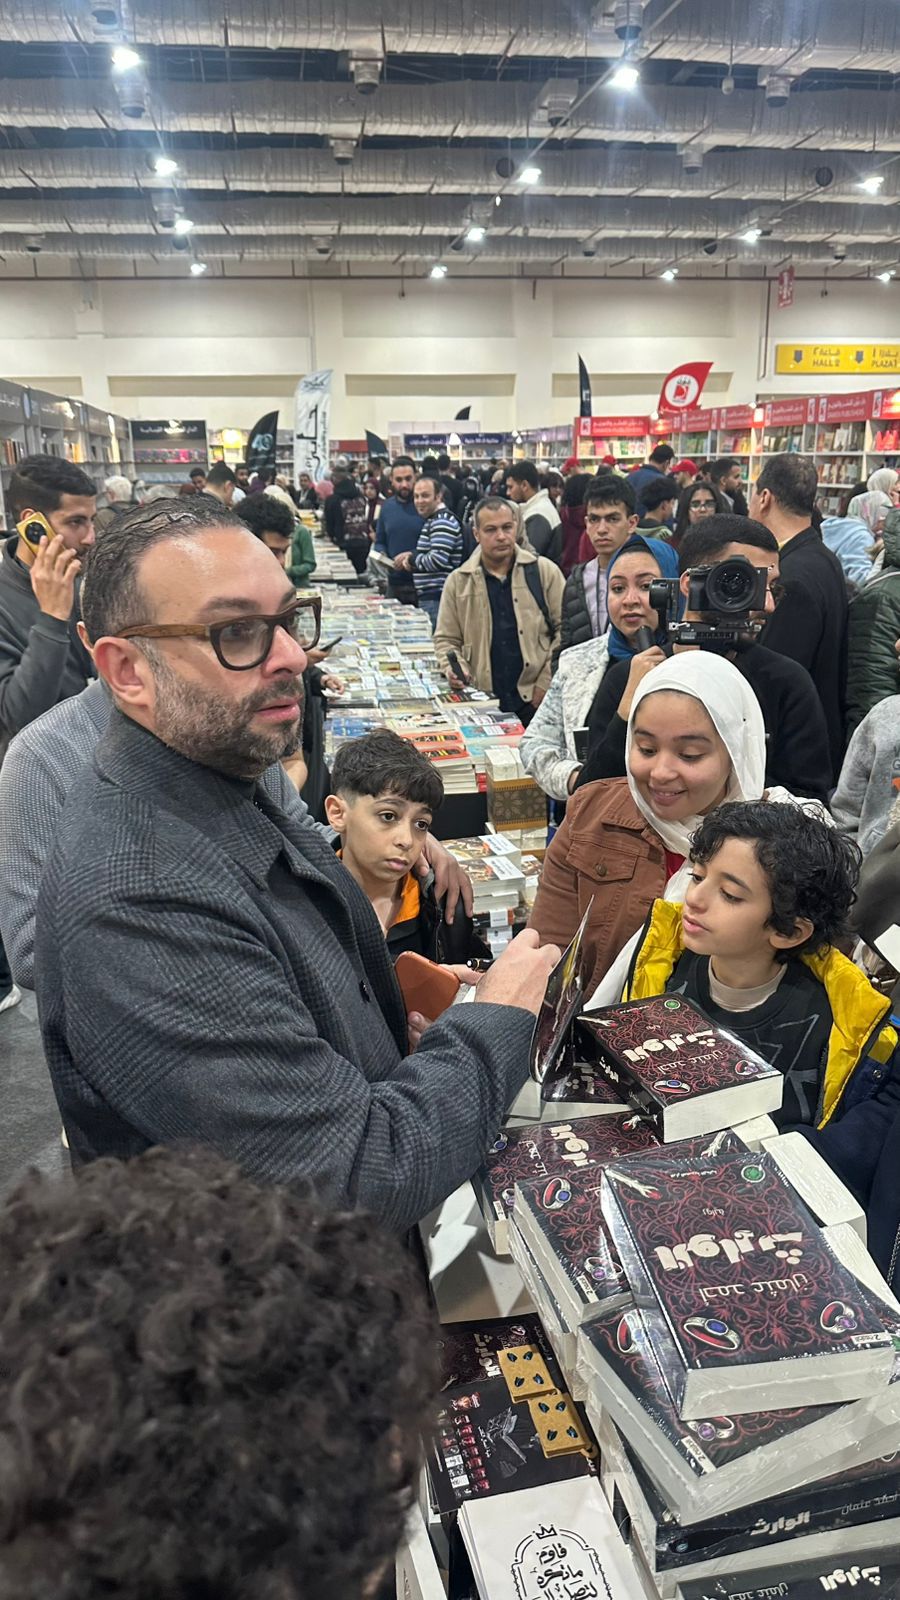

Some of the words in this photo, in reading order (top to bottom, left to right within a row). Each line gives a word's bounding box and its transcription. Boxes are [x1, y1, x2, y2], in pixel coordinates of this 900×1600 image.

[819, 347, 840, 356] قاعة
[813, 359, 832, 367] HALL
[834, 359, 840, 367] 2
[871, 359, 891, 367] PLAZA
[622, 1029, 716, 1062] الوارث
[689, 1049, 725, 1064] عثمان
[701, 1207, 725, 1217] رواية
[654, 1229, 804, 1271] الوارث
[697, 1283, 744, 1304] أحمد
[750, 1273, 809, 1297] عثمان
[474, 1333, 503, 1377] الوارث
[748, 1511, 811, 1536] الوارث
[819, 1566, 881, 1591] الوارث
[757, 1582, 788, 1600] عثمان
